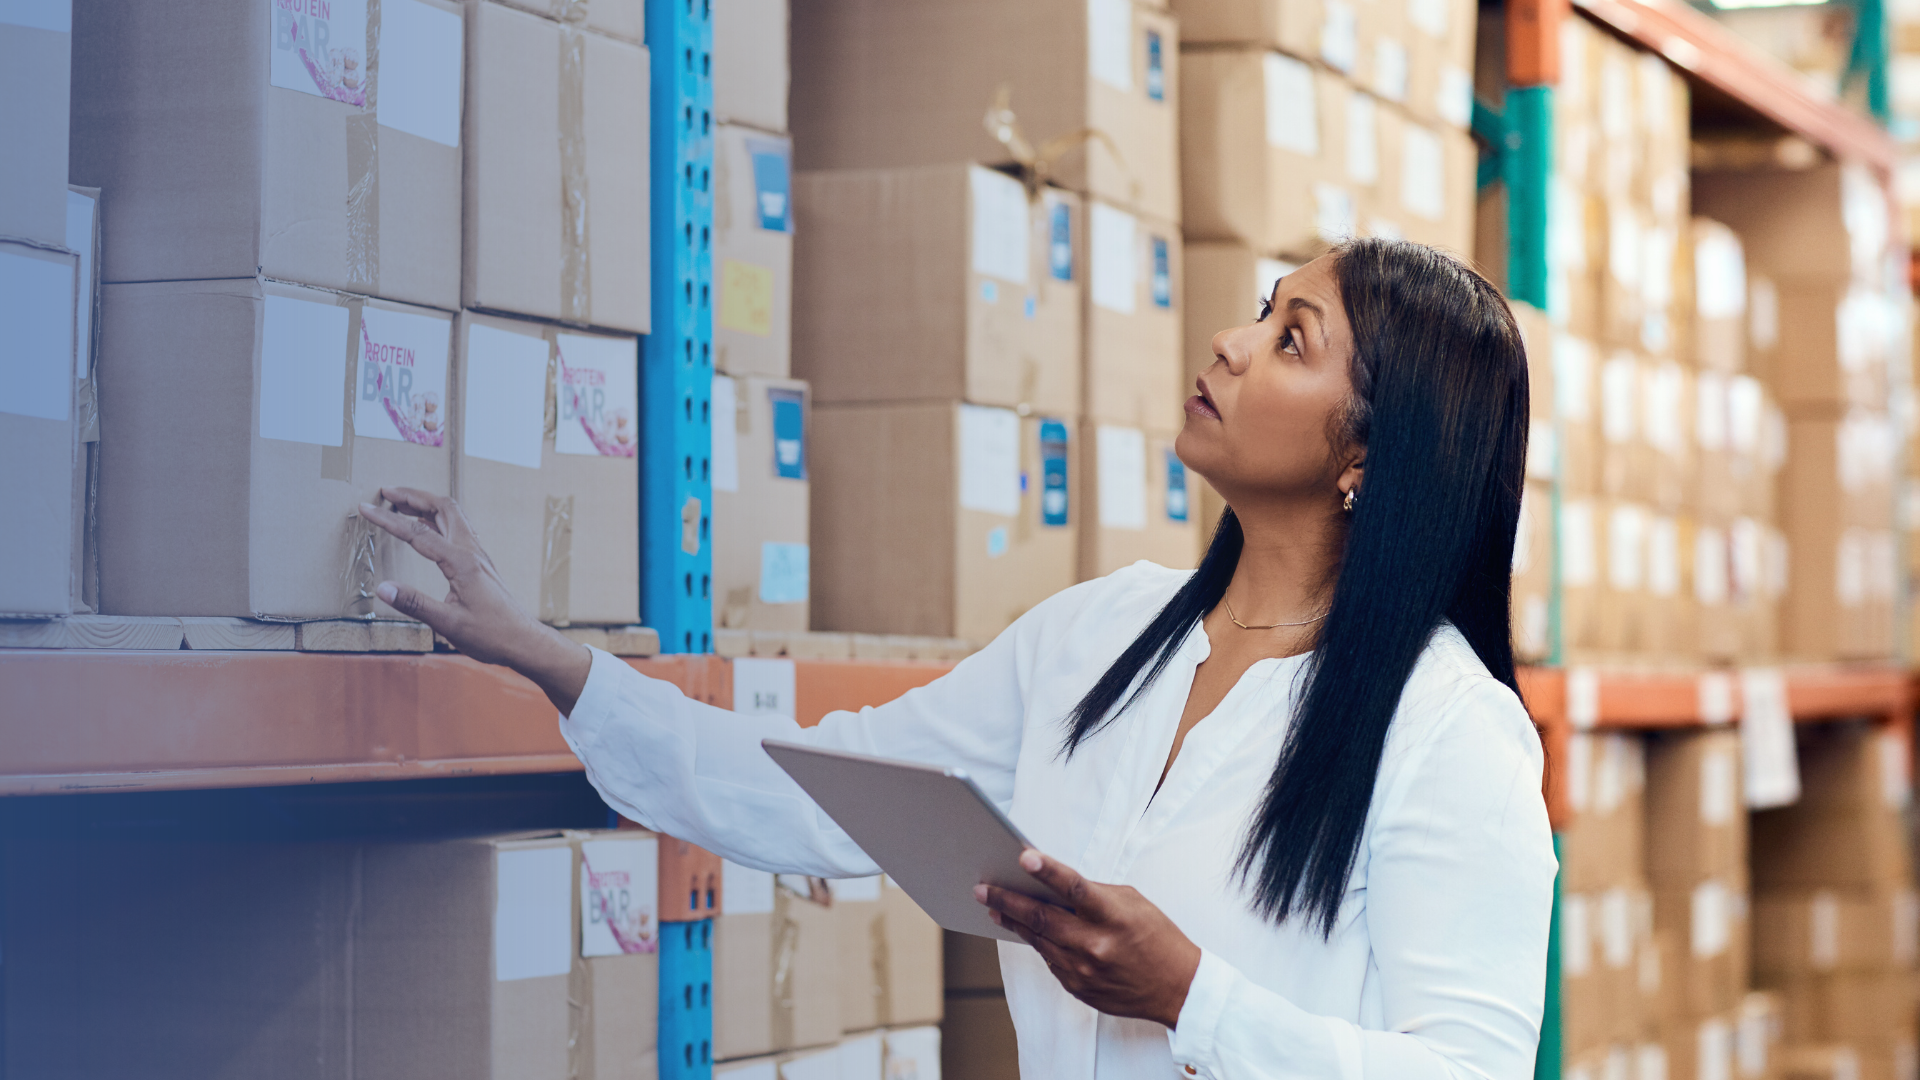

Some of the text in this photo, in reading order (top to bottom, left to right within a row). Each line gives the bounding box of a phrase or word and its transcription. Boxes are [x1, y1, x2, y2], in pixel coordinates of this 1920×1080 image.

[276, 7, 330, 62] BAR
[365, 341, 415, 367] PROTEIN
[362, 361, 413, 407] BAR
[563, 385, 604, 423] BAR
[590, 889, 630, 924] BAR
